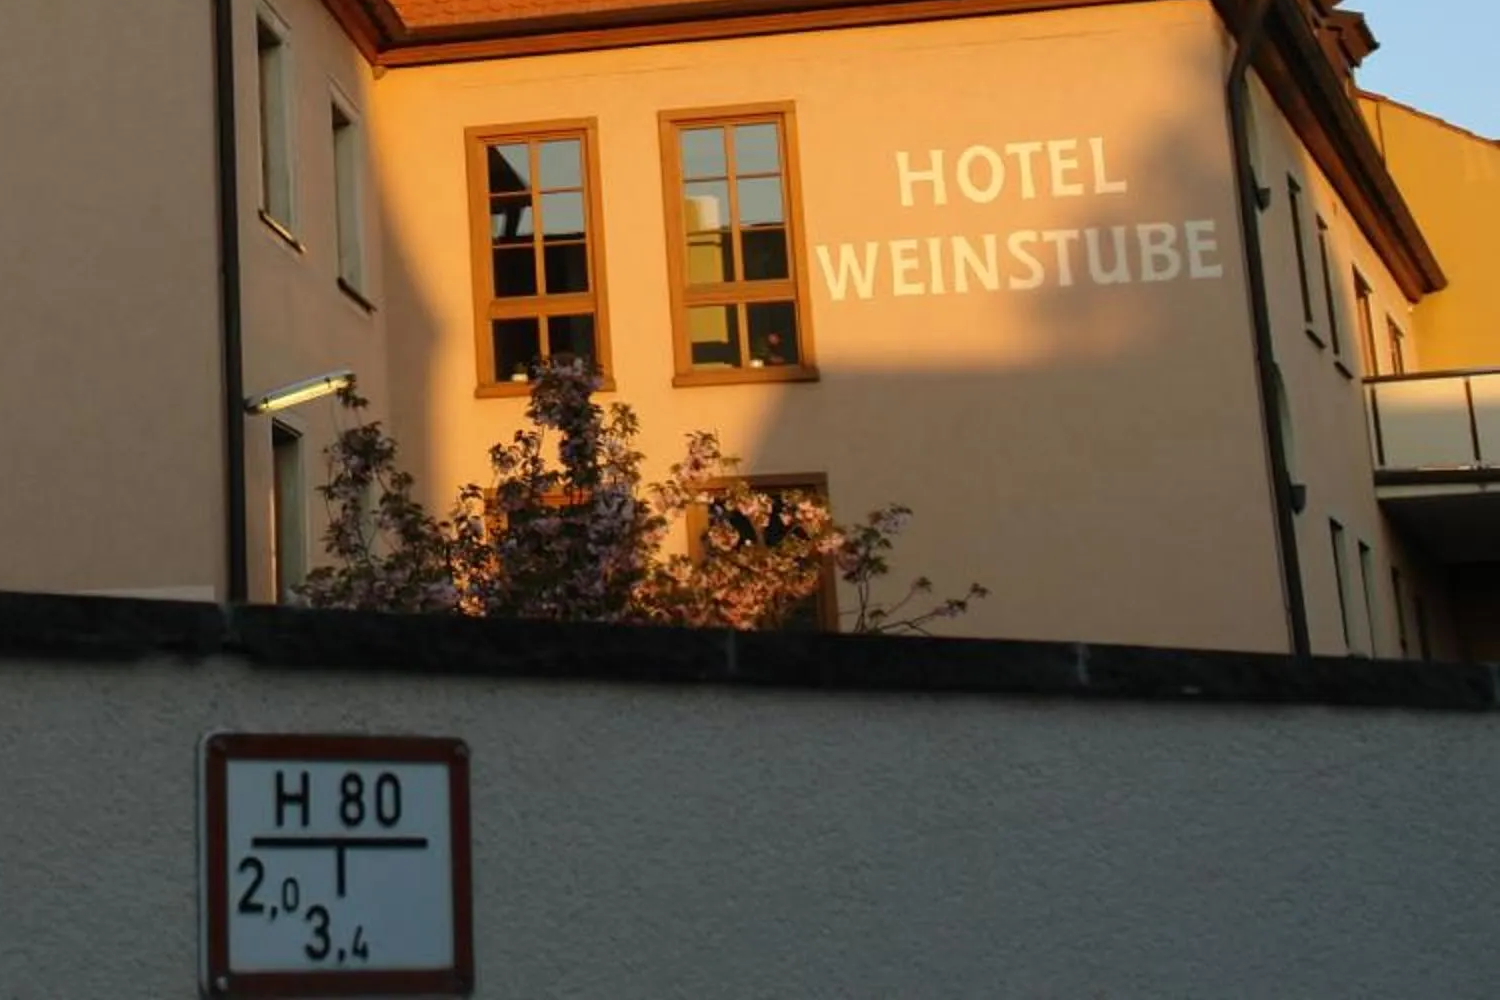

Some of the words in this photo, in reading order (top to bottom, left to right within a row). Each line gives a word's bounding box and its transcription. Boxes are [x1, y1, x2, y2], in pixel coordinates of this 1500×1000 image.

[896, 136, 1128, 207] HOTEL
[815, 218, 1224, 301] WEINSTUBE
[275, 770, 310, 828] H
[339, 771, 402, 828] 80
[237, 855, 300, 922] 2,0
[304, 903, 369, 964] 3,4
